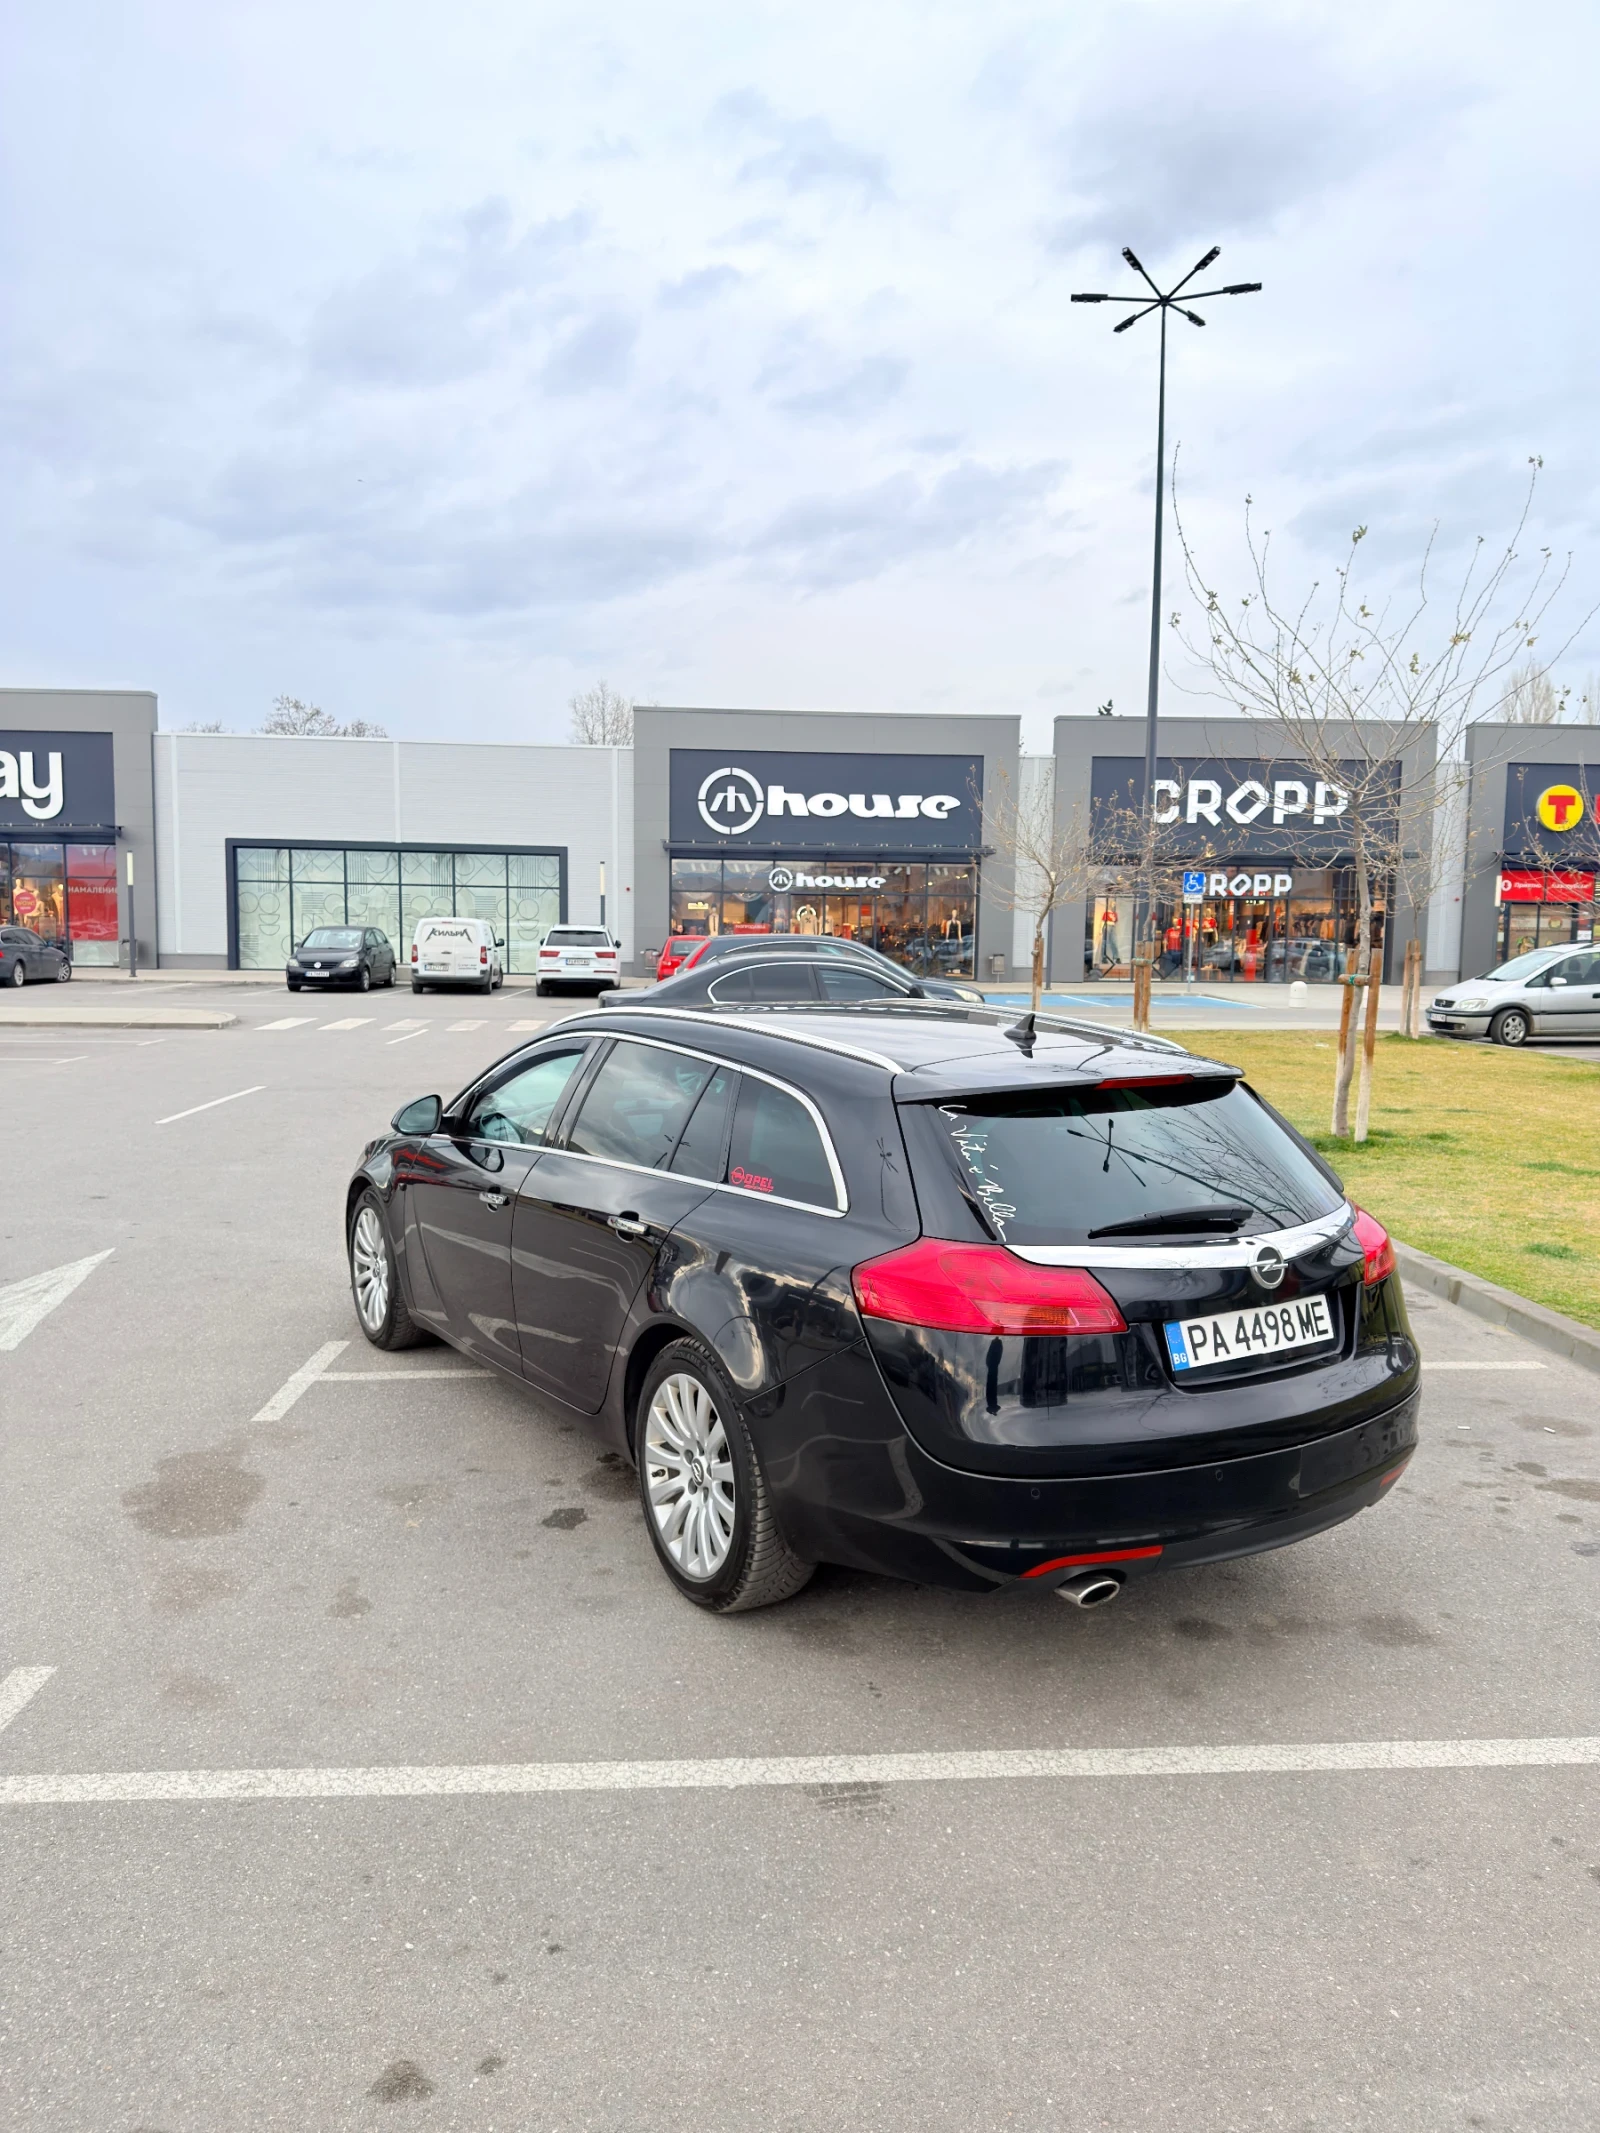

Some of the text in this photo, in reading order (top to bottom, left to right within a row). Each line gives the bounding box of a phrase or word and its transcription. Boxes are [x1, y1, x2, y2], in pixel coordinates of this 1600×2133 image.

[767, 784, 962, 820] house
[1154, 779, 1349, 827] CROPP
[1548, 795, 1576, 825] T
[796, 872, 887, 889] house
[1203, 873, 1293, 897] ROPP
[744, 1173, 774, 1189] OPEL
[977, 1178, 1017, 1243] Bella
[1172, 1301, 1329, 1365] BG PA 4498 ME
